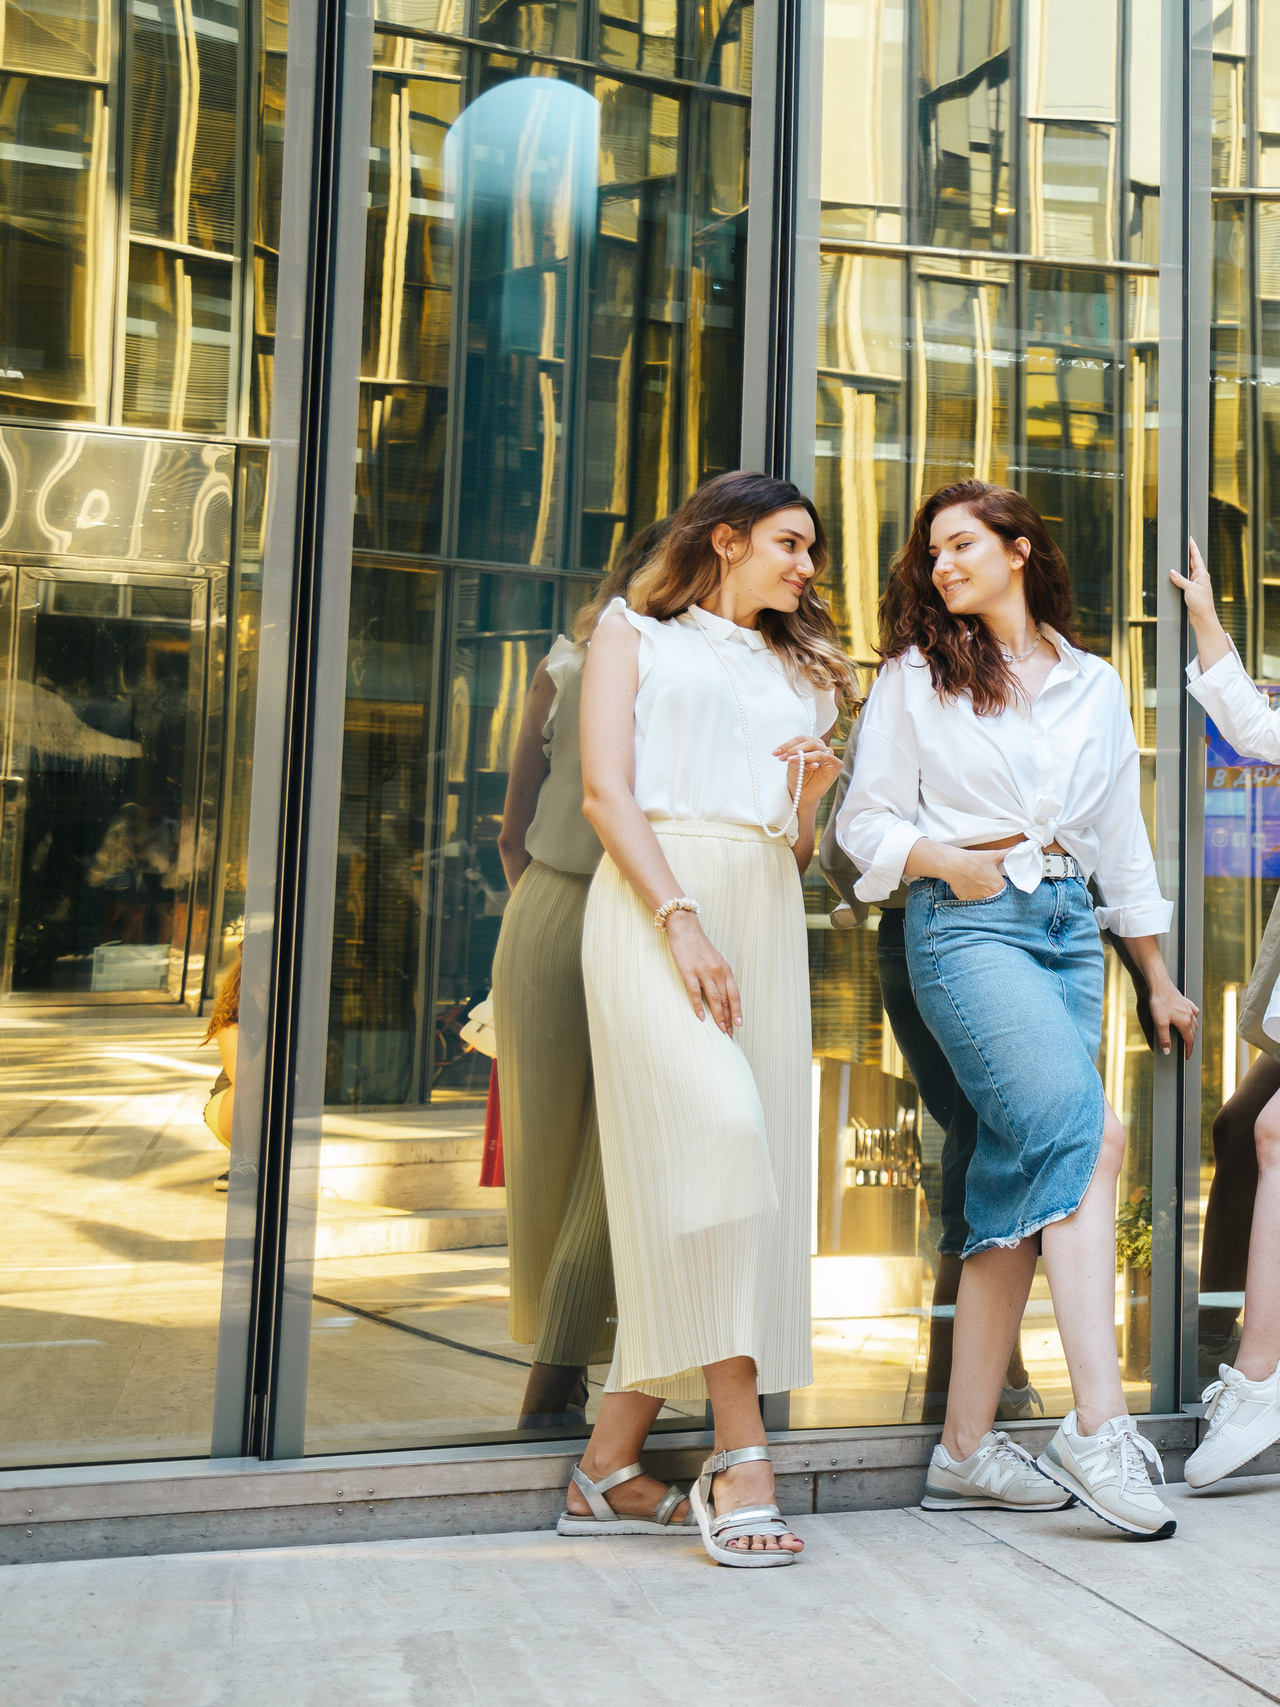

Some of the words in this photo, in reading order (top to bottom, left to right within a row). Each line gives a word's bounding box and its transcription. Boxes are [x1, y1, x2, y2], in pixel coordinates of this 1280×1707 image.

[1212, 769, 1228, 788] В
[976, 1462, 1016, 1494] N
[1080, 1454, 1117, 1488] N
